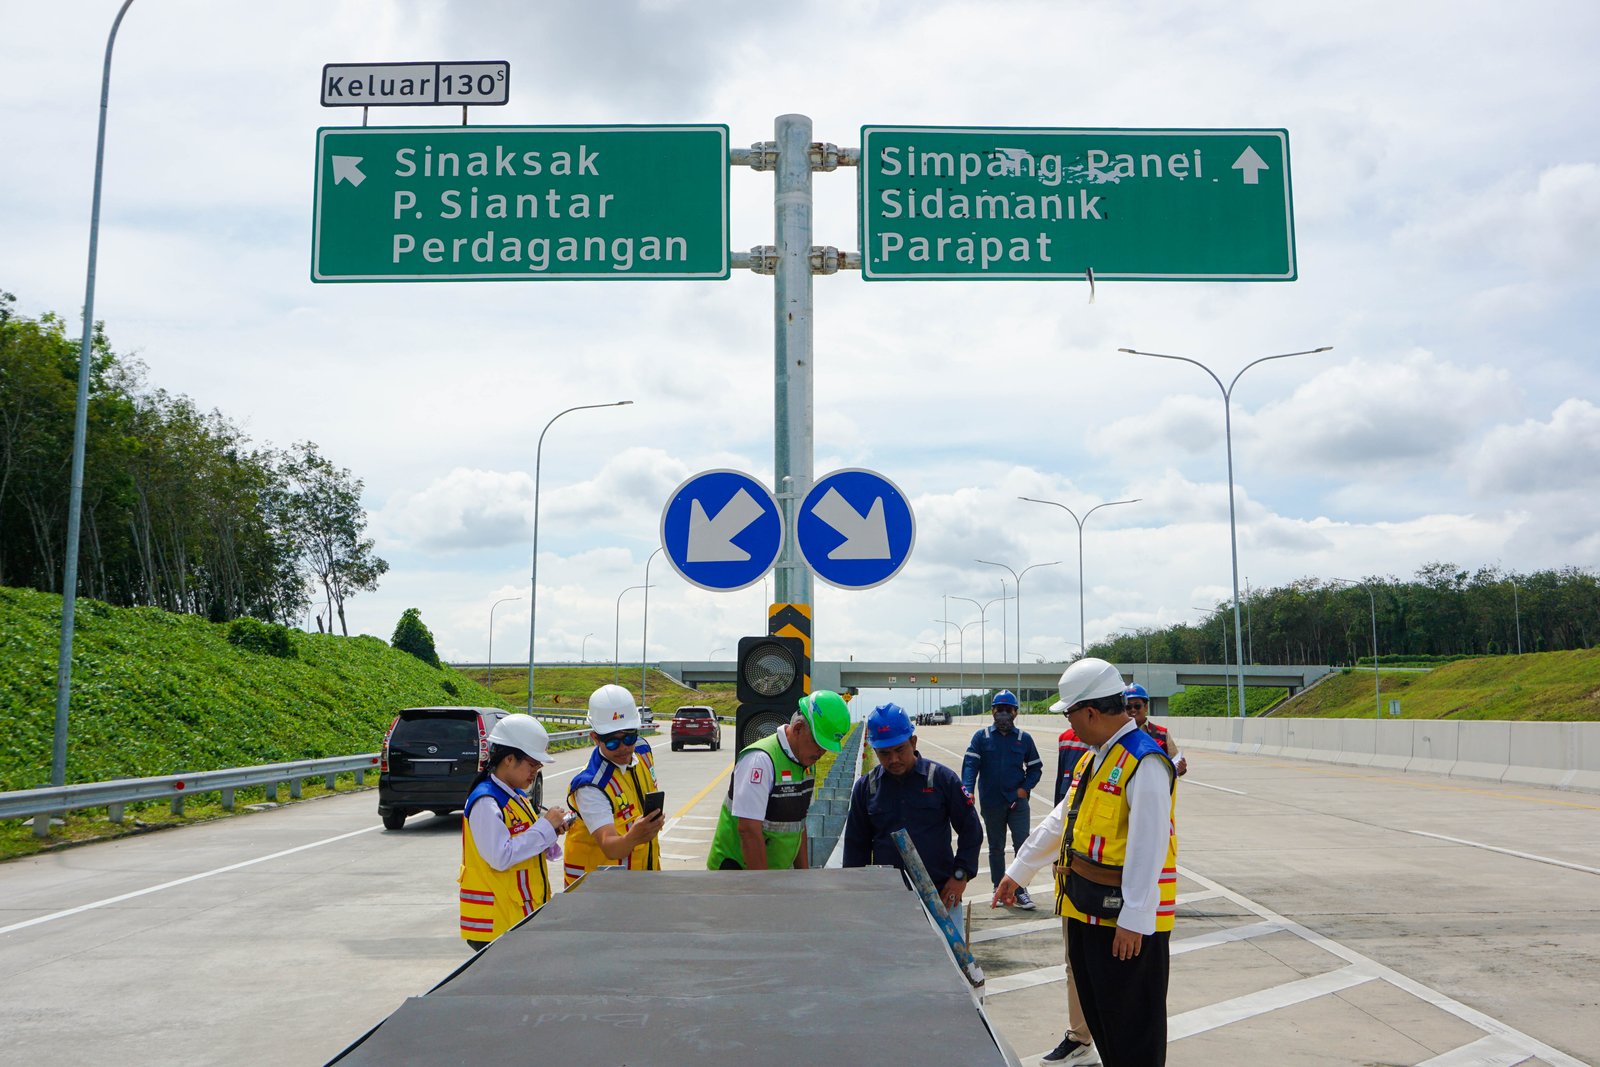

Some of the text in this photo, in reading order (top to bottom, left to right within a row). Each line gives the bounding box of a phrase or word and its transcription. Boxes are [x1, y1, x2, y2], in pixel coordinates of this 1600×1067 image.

[328, 74, 431, 97] Keluar
[395, 145, 600, 177] Sinaksak
[880, 146, 1202, 187] Simpang Panei
[394, 186, 614, 220] P. Siantar
[881, 187, 1103, 220] Sidamanik
[392, 230, 687, 271] Perdagangan
[880, 232, 1052, 270] Parapat
